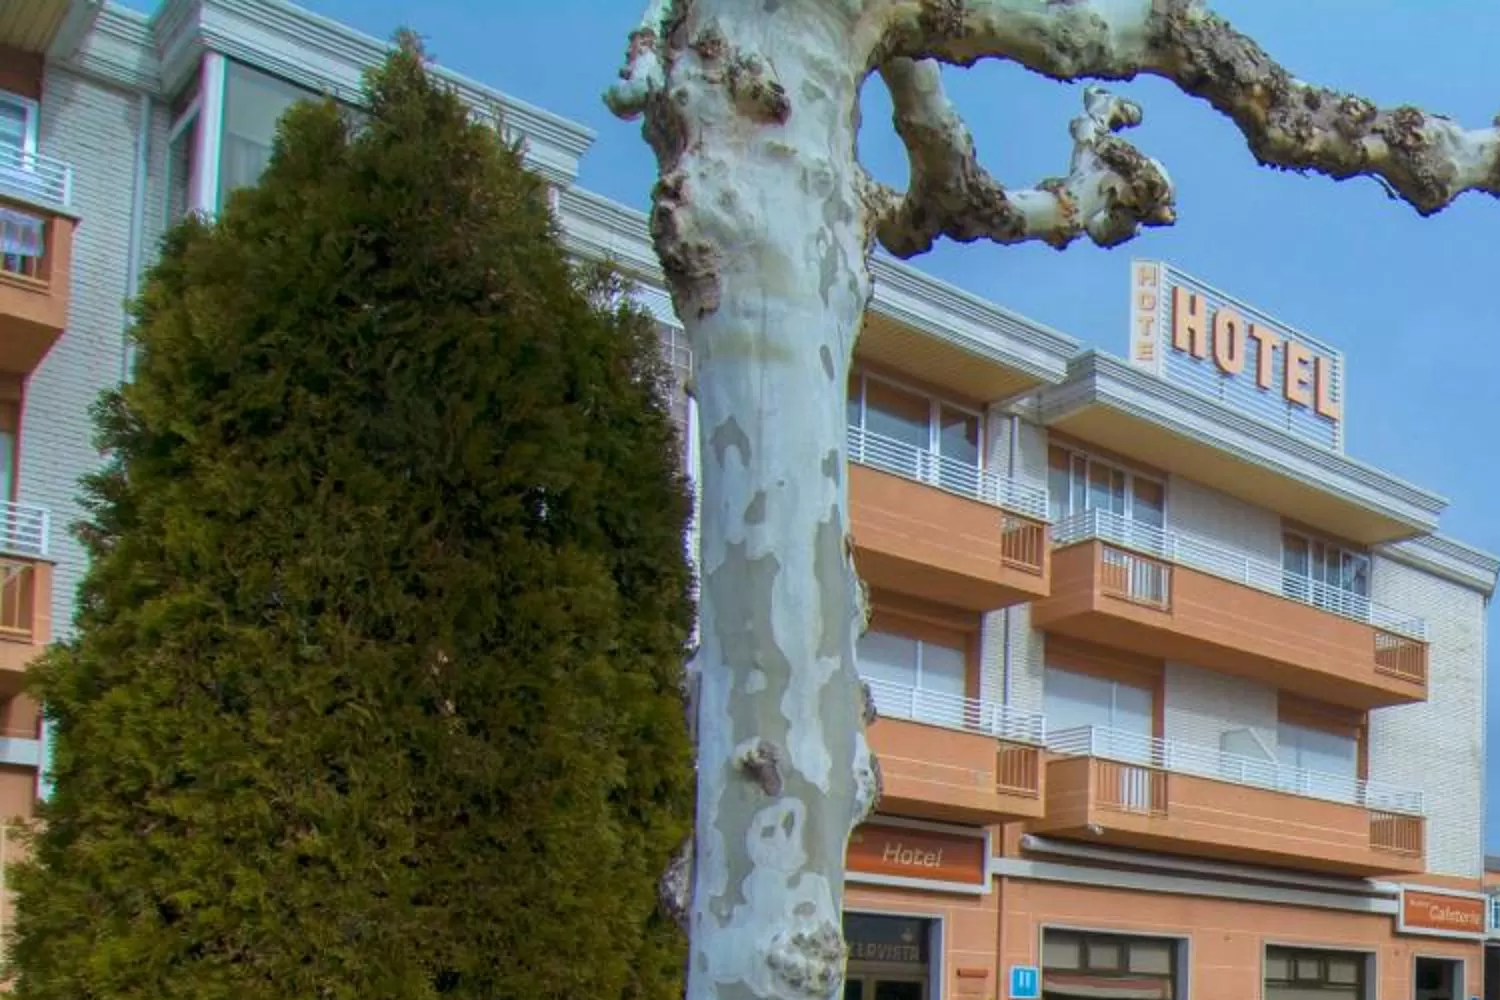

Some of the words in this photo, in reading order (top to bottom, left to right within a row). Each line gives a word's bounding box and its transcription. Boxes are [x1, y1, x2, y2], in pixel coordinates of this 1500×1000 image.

[1136, 265, 1157, 361] HOTE
[1172, 285, 1340, 421] HOTEL
[882, 842, 943, 868] Hotel
